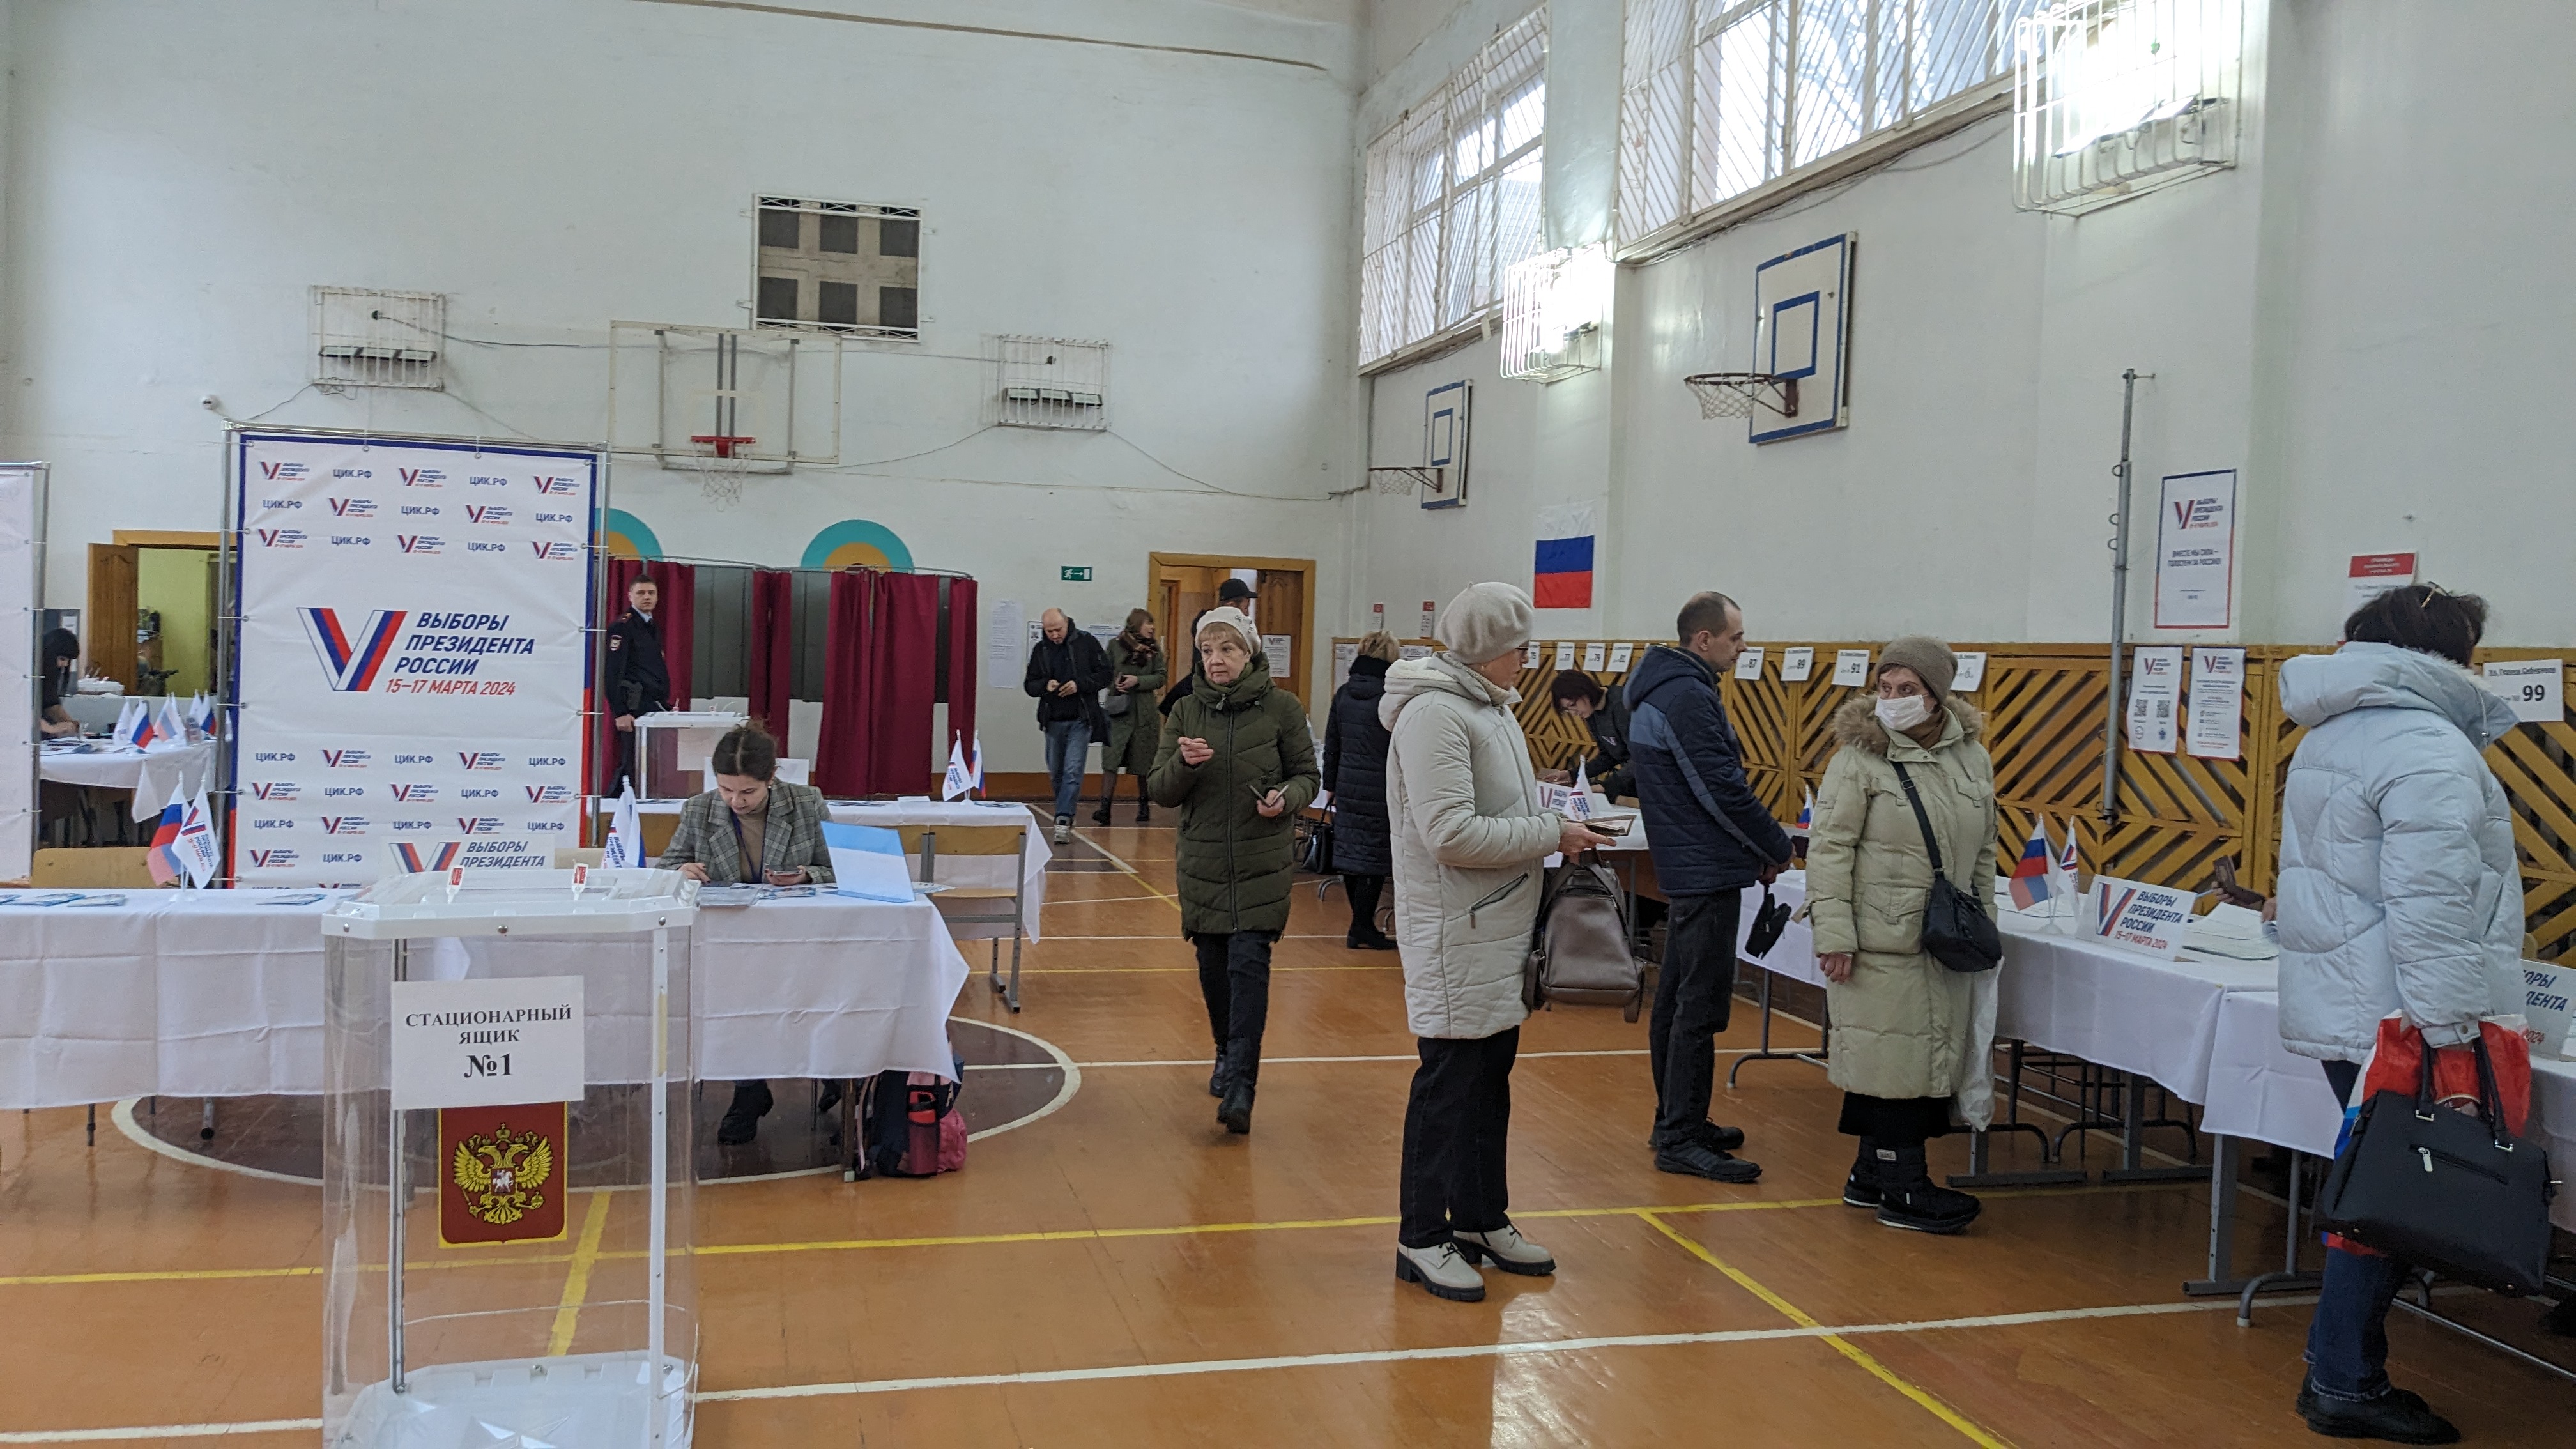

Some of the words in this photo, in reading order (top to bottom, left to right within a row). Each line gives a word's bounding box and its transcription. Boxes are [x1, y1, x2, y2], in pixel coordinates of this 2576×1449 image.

[333, 469, 372, 479] ЦИК.РФ
[470, 476, 507, 486] ЦИК.РФ
[263, 500, 302, 509] ЦИК.РФ
[401, 506, 440, 515] ЦИК.РФ
[536, 513, 572, 523] ЦИК.РФ
[331, 536, 371, 546] ЦИК.РФ
[468, 542, 505, 552] ЦИК.РФ
[417, 612, 509, 631] ВЫБОРЫ
[405, 635, 535, 655] ПРЕЗИДЕНТА
[394, 657, 479, 675] РОССИИ
[1748, 659, 1758, 668] 87
[1851, 663, 1861, 673] 91
[427, 680, 478, 695] МАРТА
[480, 681, 516, 696] 2024
[2522, 684, 2545, 702] 99
[256, 753, 295, 762] ЦИК.РФ
[395, 755, 433, 763] ЦИК.РФ
[529, 757, 566, 767] ЦИК.РФ
[325, 787, 364, 797] ЦИК.РФ
[461, 789, 499, 799] ЦИК.РФ
[254, 820, 294, 829] ЦИК.РФ
[394, 821, 432, 830] ЦИК.РФ
[528, 822, 565, 831] ЦИК.РФ
[466, 841, 528, 853] ВЫБОРЫ
[323, 854, 362, 863] ЦИК.РФ
[460, 855, 546, 869] ПРЕЗИДЕНТА
[2136, 891, 2178, 907] ВЫБОРЫ
[2128, 903, 2184, 923] ПРЕЗИДЕНТА
[2120, 917, 2156, 933] РОССИИ
[2524, 969, 2557, 988] ОРЫ
[405, 1004, 572, 1028] СТАЦИОНАРНЫЙ
[459, 1029, 520, 1046] ЯЩИК
[2526, 1030, 2545, 1045] 024
[464, 1053, 513, 1078] №1
